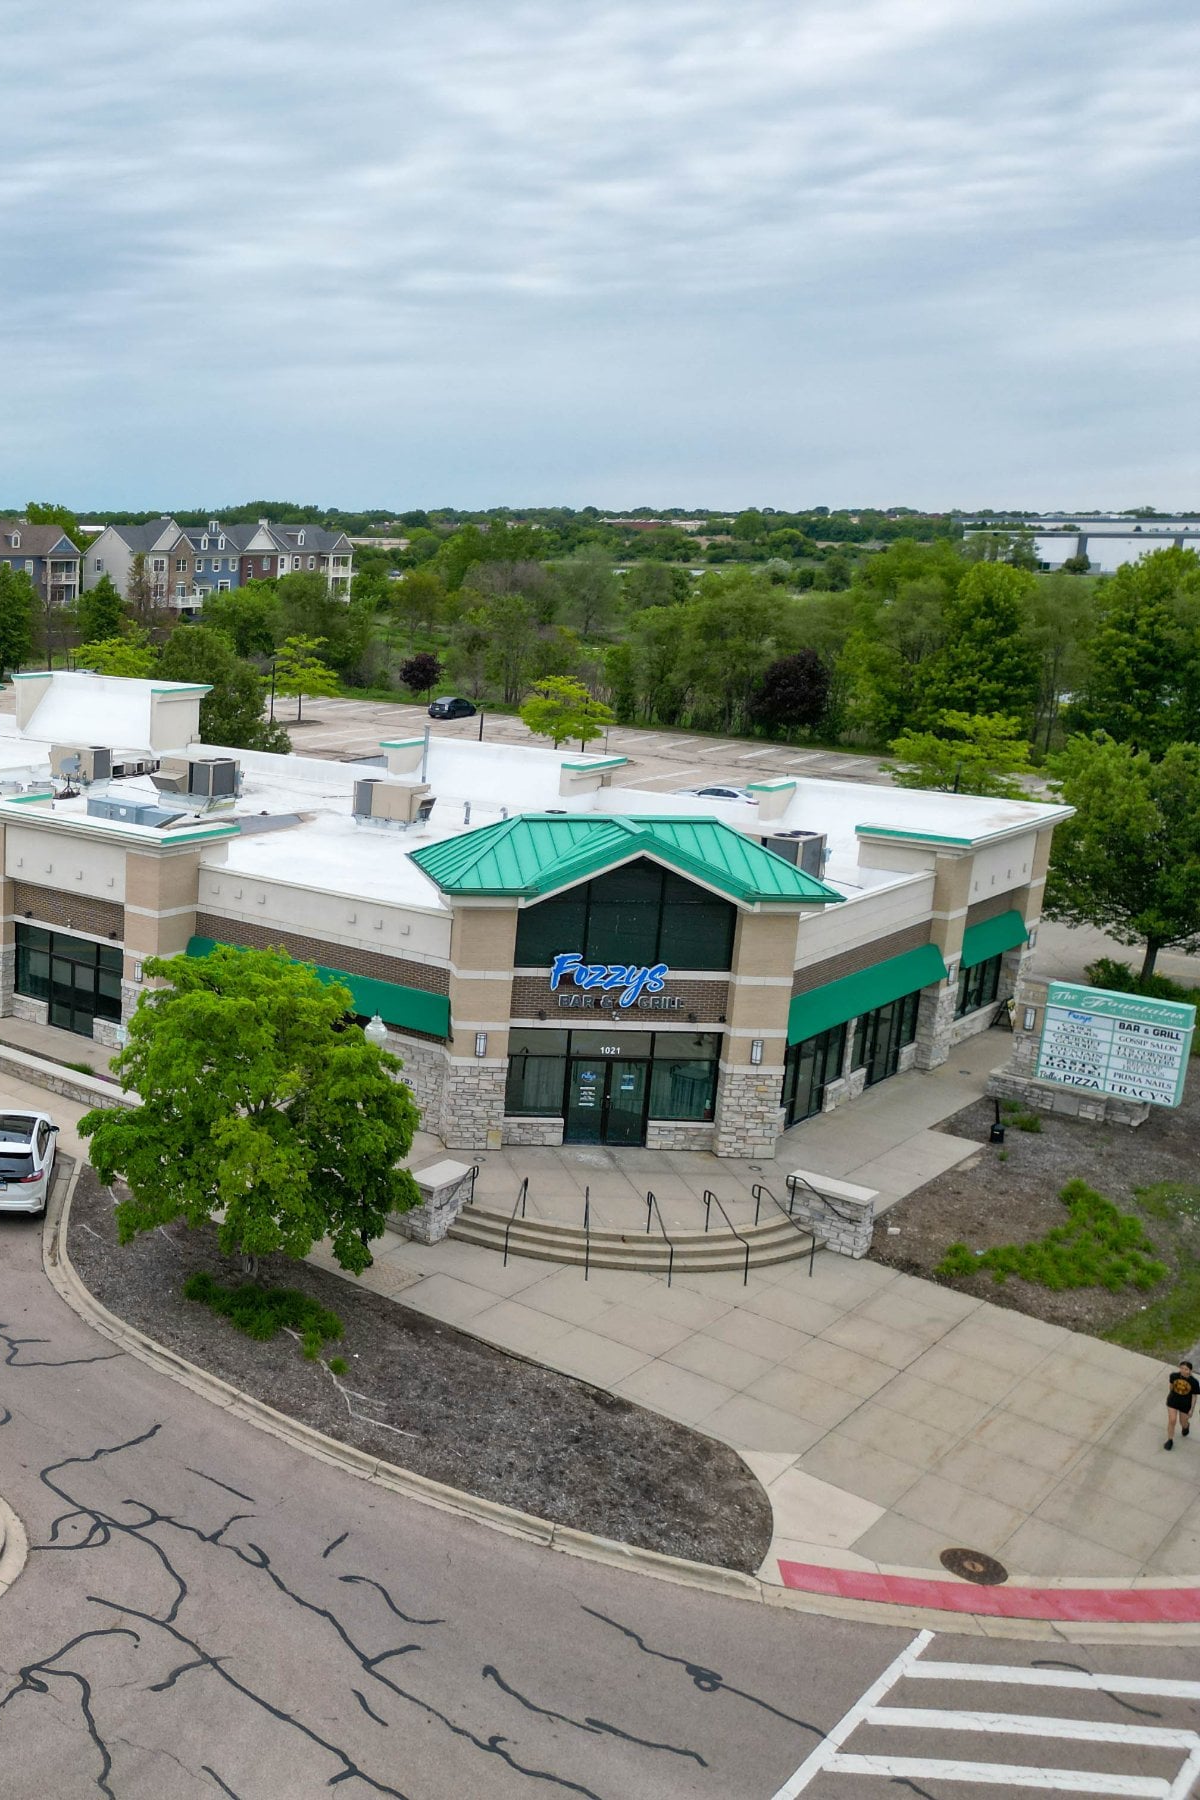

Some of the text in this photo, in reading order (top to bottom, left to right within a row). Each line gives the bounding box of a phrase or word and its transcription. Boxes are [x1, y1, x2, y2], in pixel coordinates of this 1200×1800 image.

[550, 952, 669, 1008] Fozzys
[558, 994, 685, 1010] BAR & GRILL
[1052, 991, 1078, 1001] The
[1081, 995, 1185, 1019] Fountains
[1118, 1022, 1140, 1032] BAR
[1152, 1028, 1181, 1040] GRILL
[600, 1046, 620, 1055] 1021
[1049, 1044, 1102, 1059] FOUNTAIN
[1118, 1035, 1177, 1052] GOSSIP SALON
[1063, 1074, 1099, 1089] PIZZA
[1113, 1072, 1171, 1089] PRIMA NAILS
[1107, 1082, 1171, 1103] TRACY'S
